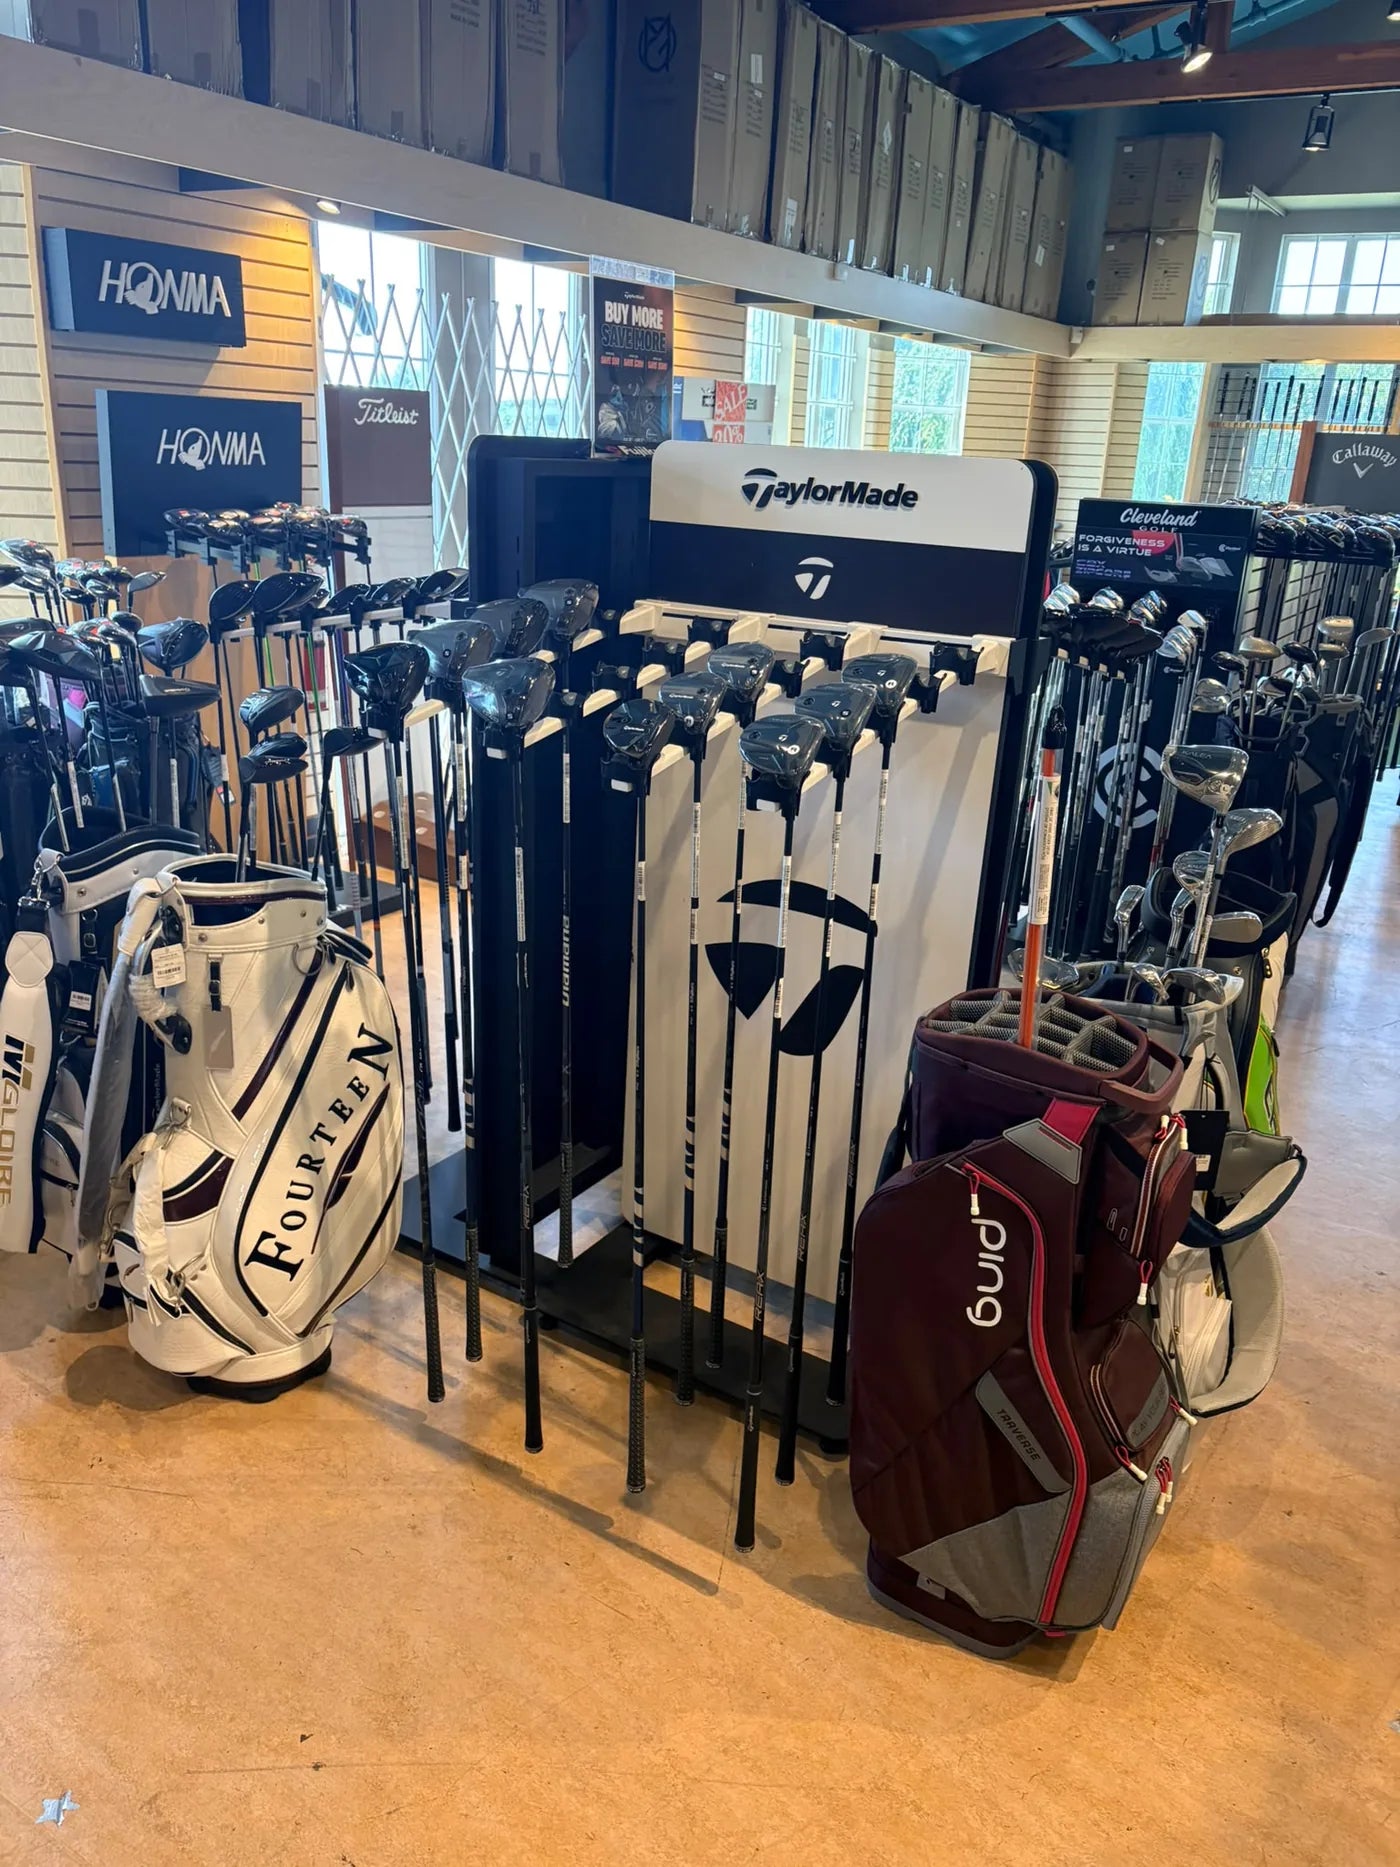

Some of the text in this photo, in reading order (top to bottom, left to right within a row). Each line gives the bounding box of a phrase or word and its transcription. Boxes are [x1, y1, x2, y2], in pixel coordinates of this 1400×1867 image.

[98, 260, 231, 317] HONMA
[605, 301, 664, 330] BUY MORE
[601, 323, 667, 354] SAVE MORE
[353, 398, 419, 426] Titleist
[156, 427, 266, 471] HONMA
[1332, 442, 1397, 467] Callaway
[742, 468, 919, 511] TaylorMade
[1120, 507, 1199, 527] Cleveland
[1078, 544, 1152, 557] IS A VIRTUE
[1079, 534, 1166, 548] FORGIVENESS
[244, 1022, 394, 1282] FOURTEEN
[966, 1217, 1007, 1328] ping
[755, 1269, 765, 1322] REAX
[997, 1408, 1041, 1461] TRAVERSE
